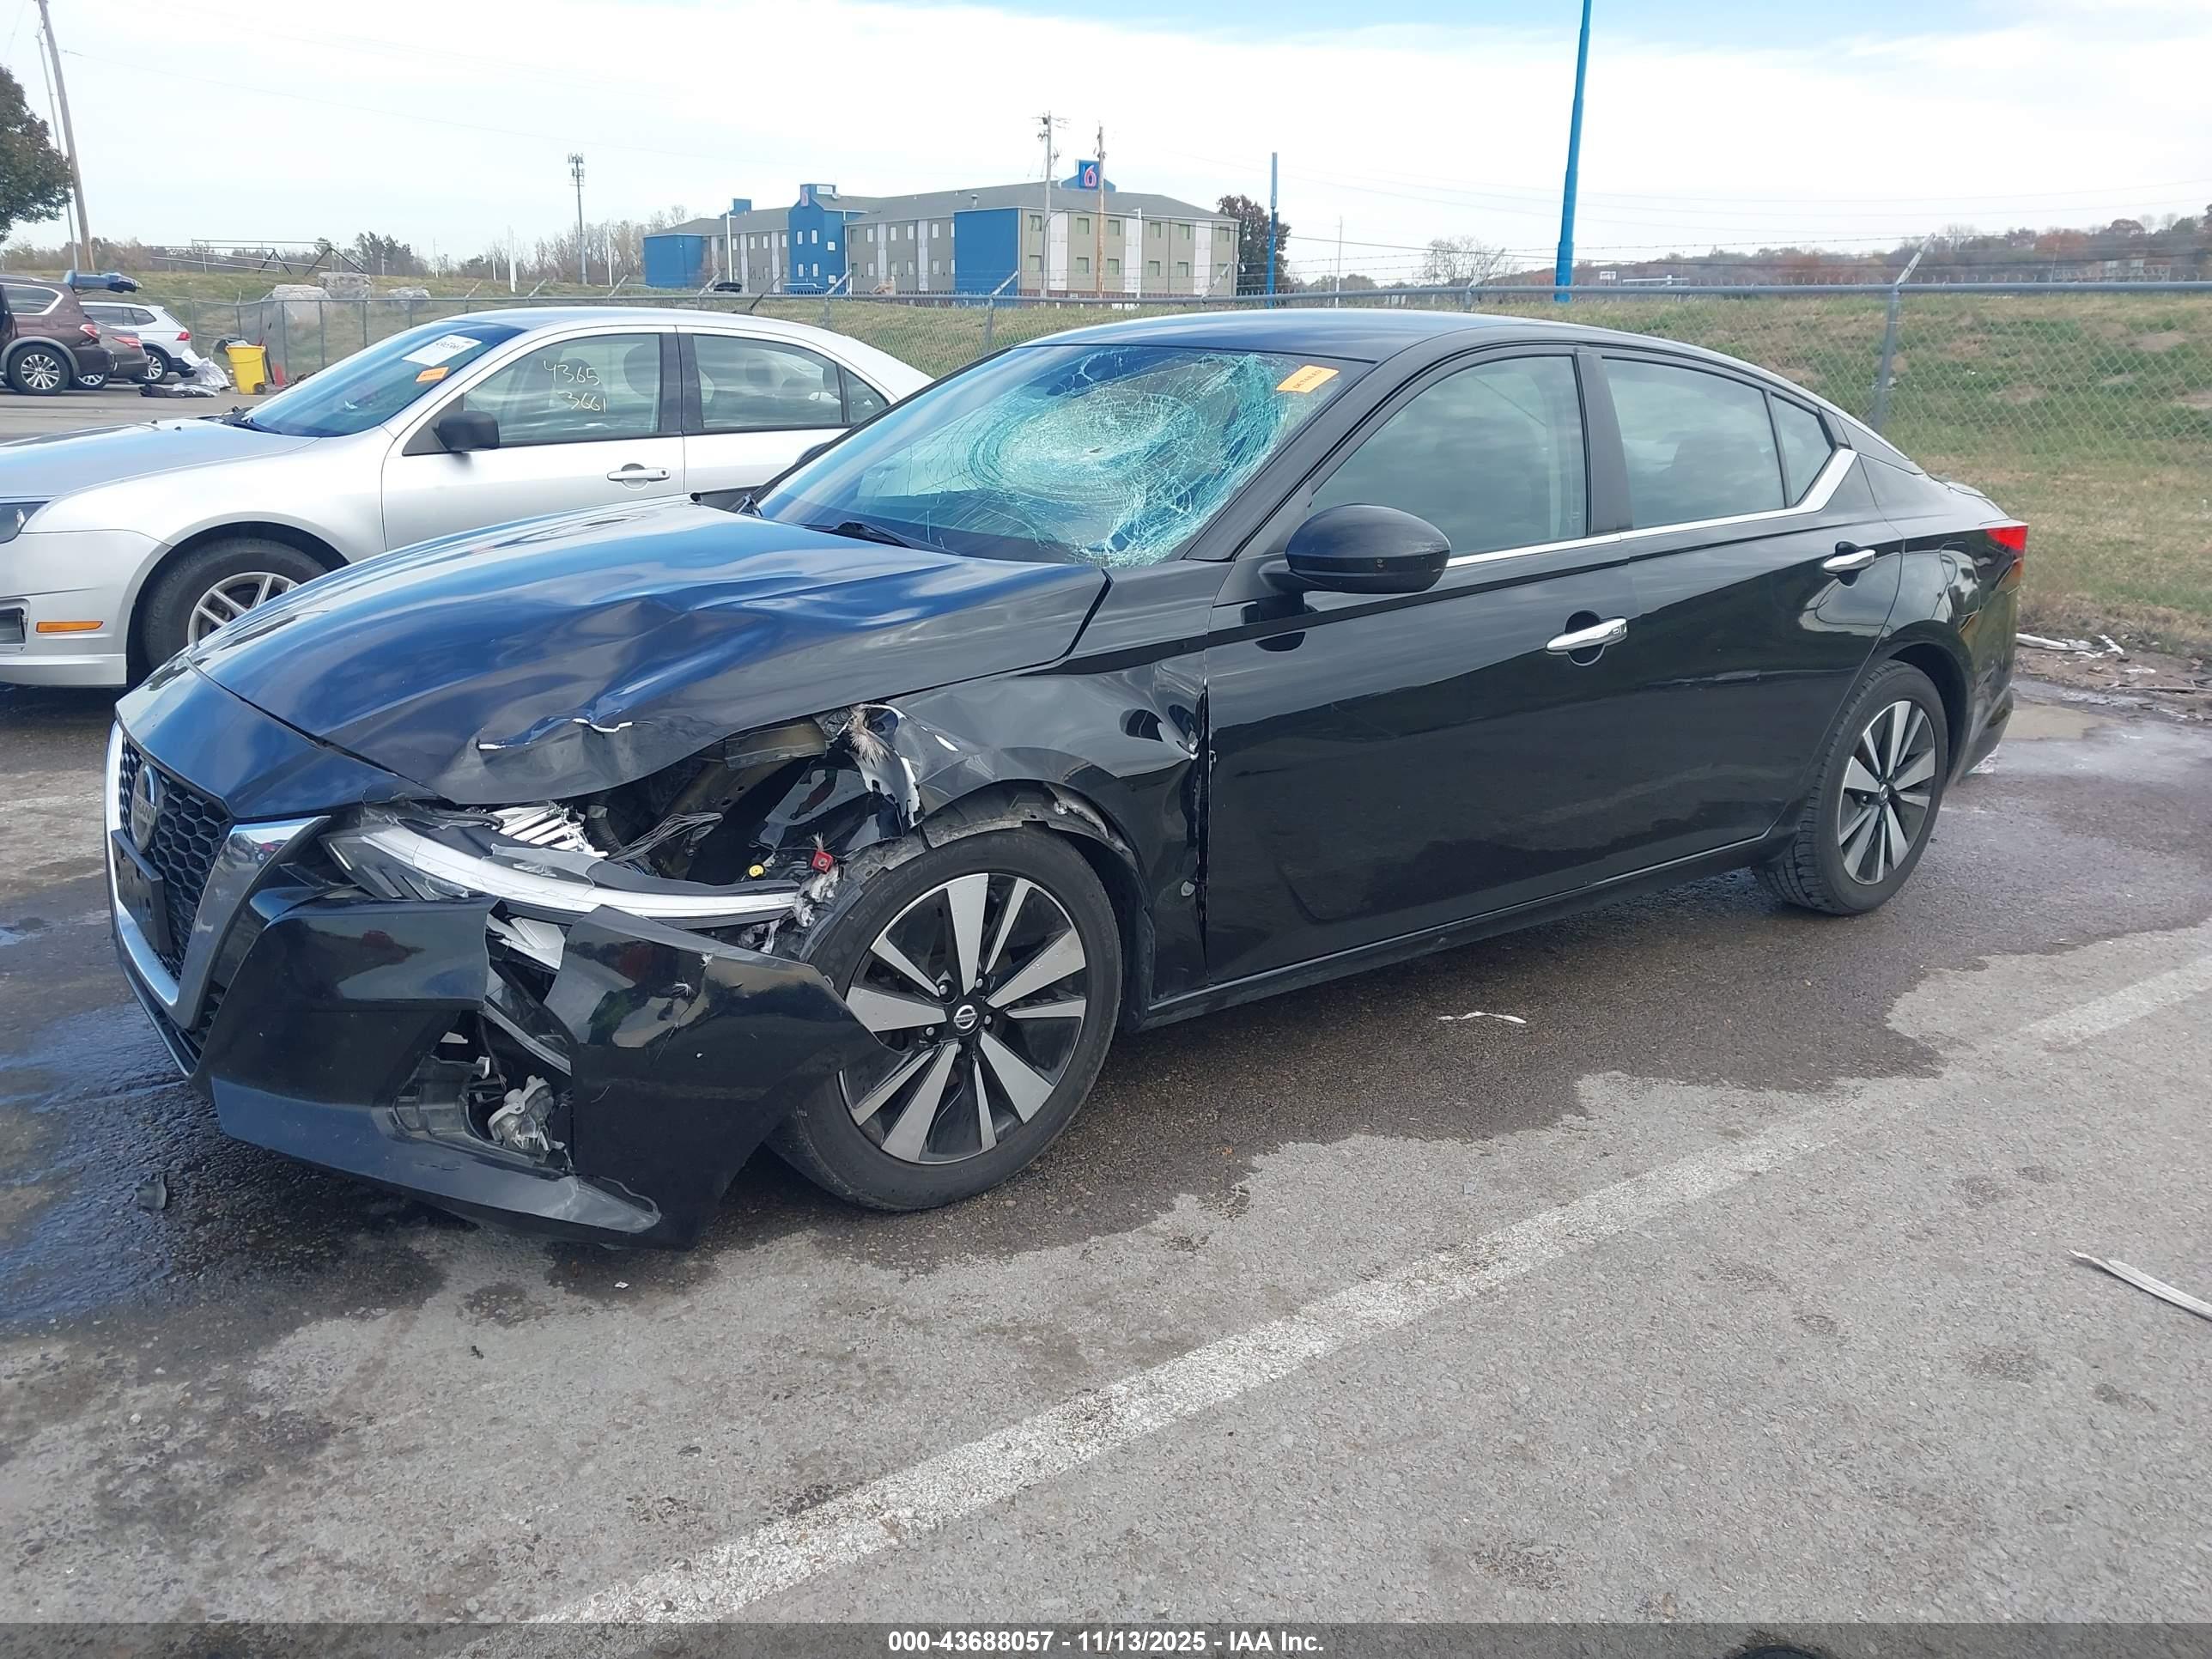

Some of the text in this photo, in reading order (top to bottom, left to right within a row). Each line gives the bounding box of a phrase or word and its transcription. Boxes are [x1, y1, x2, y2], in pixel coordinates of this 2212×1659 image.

[1085, 164, 1097, 187] 6
[543, 360, 600, 386] 4365
[557, 391, 606, 413] 3661
